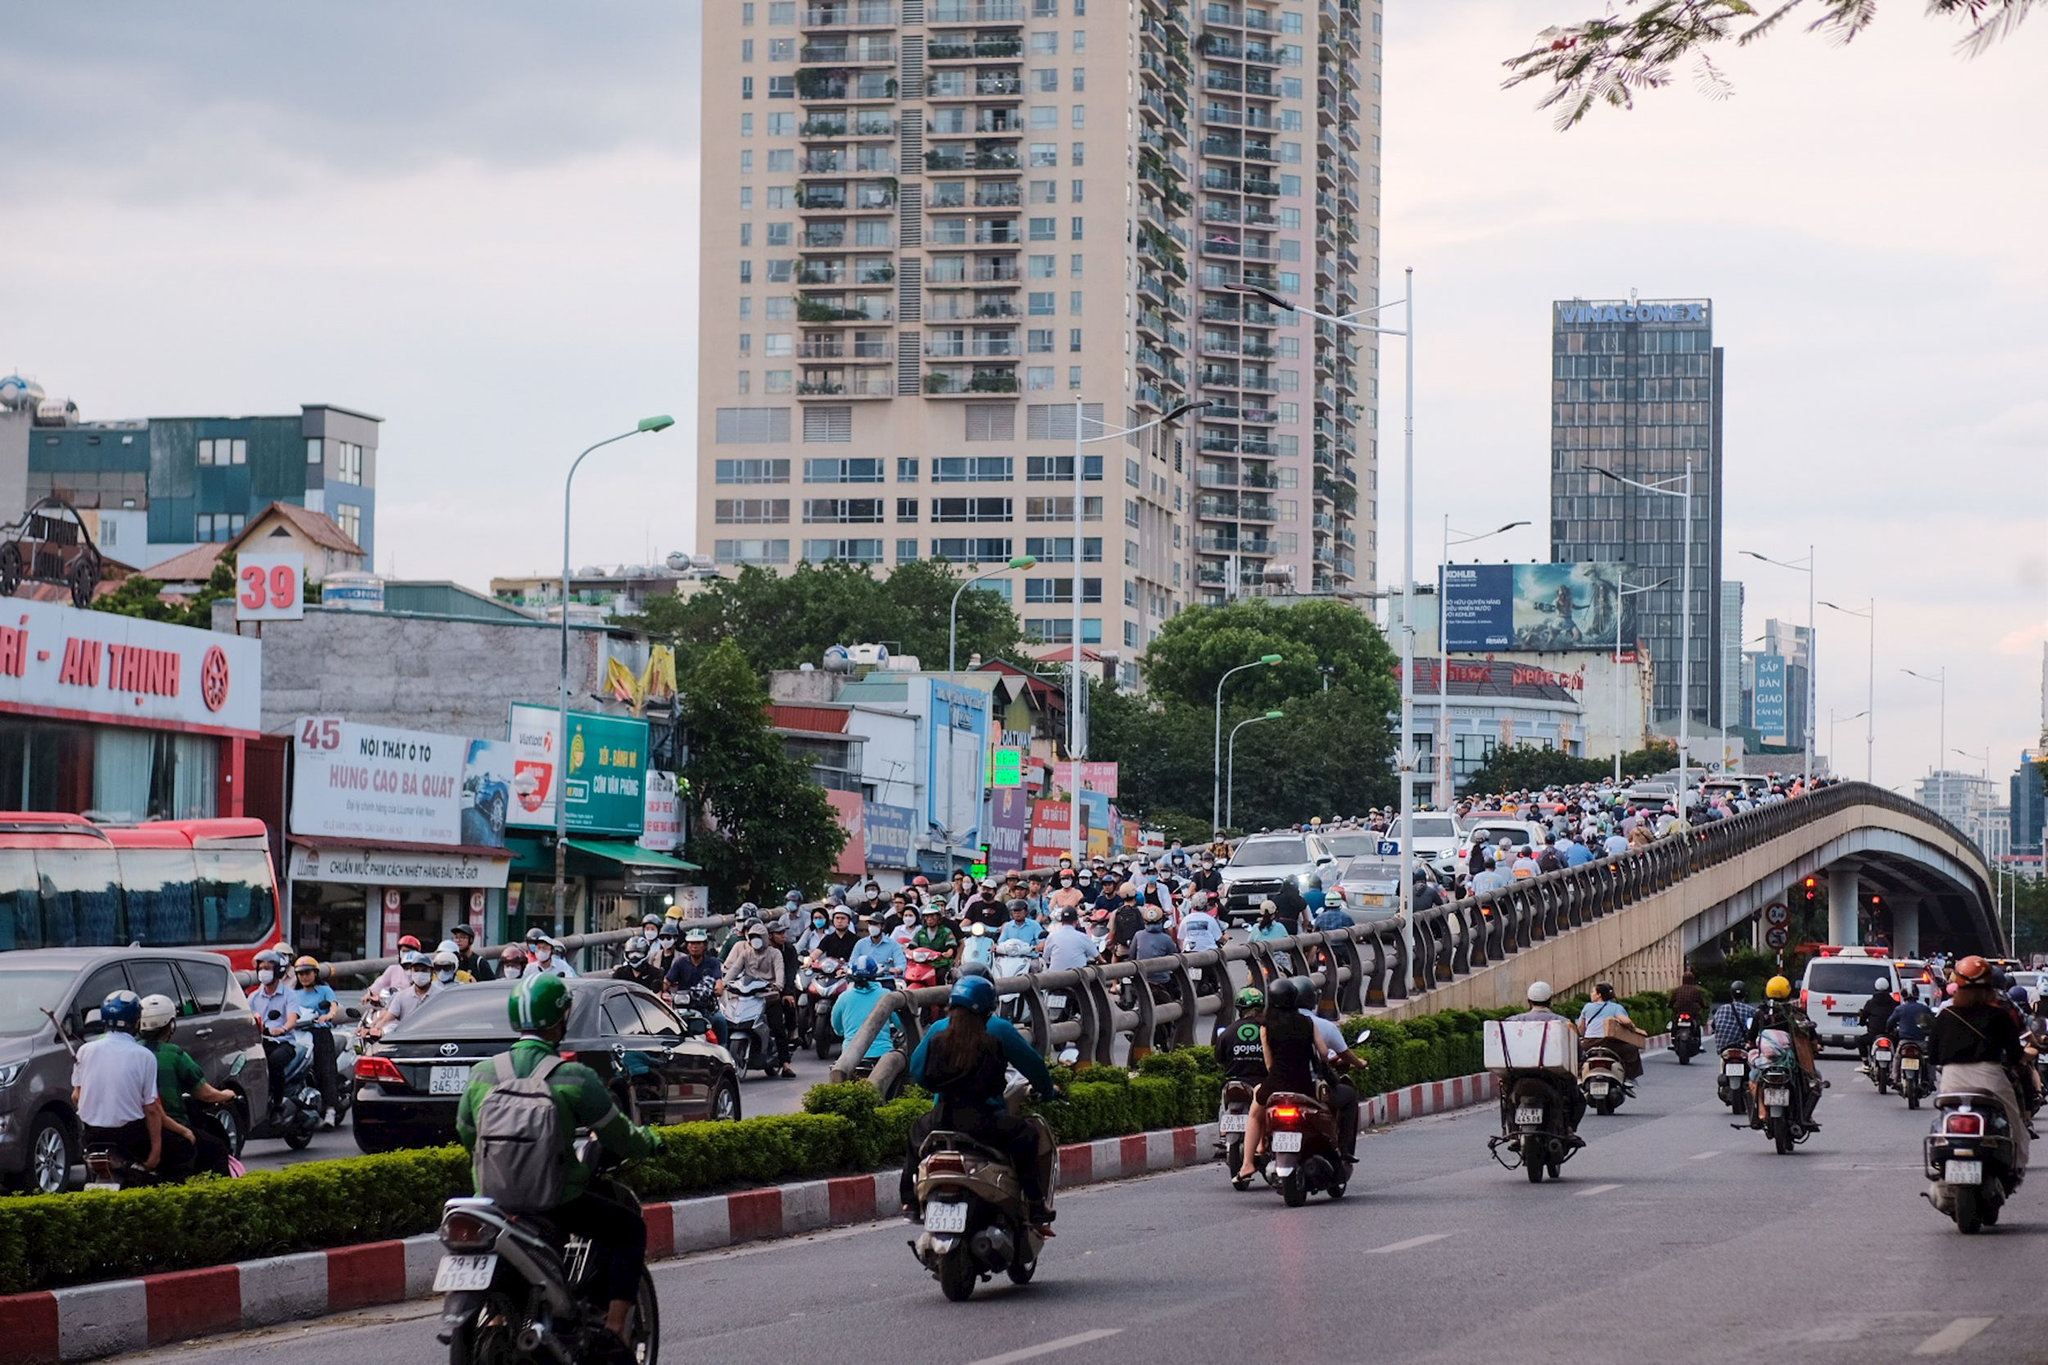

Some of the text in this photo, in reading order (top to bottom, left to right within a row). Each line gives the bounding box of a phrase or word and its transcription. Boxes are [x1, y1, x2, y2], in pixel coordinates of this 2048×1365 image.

[1561, 304, 1703, 323] VINACONEX
[240, 565, 295, 610] 39
[59, 637, 102, 687] AN
[108, 643, 181, 706] THỊNH
[1759, 676, 1780, 688] BÀN
[1756, 694, 1782, 703] GIAO
[301, 720, 341, 750] 45
[360, 734, 379, 761] NỘI
[373, 769, 398, 793] CAO
[1233, 1044, 1264, 1055] gojek
[440, 1067, 460, 1079] 30A
[448, 1255, 489, 1270] 29-V3
